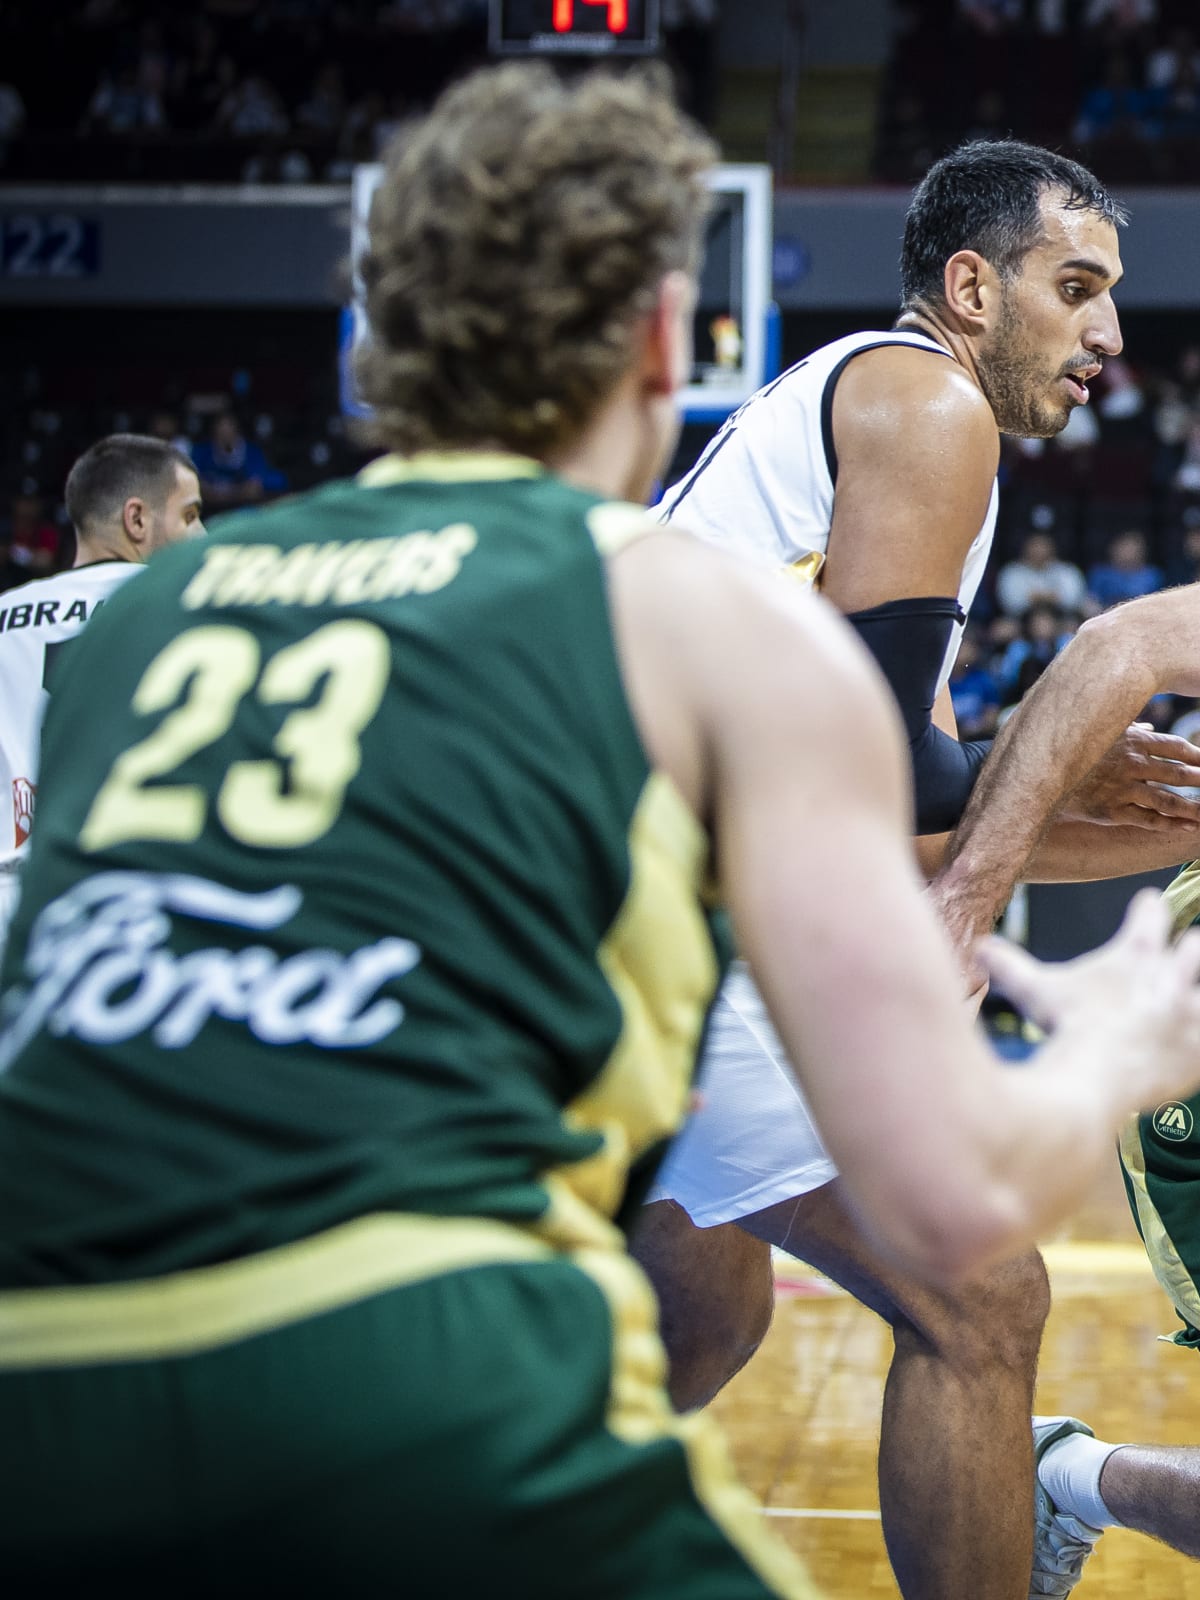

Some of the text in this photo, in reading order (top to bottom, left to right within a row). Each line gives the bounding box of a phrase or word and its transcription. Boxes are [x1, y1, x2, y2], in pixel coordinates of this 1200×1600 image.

[180, 522, 479, 612] TRAVERS
[80, 618, 391, 852] 23
[0, 868, 422, 1072] Ford
